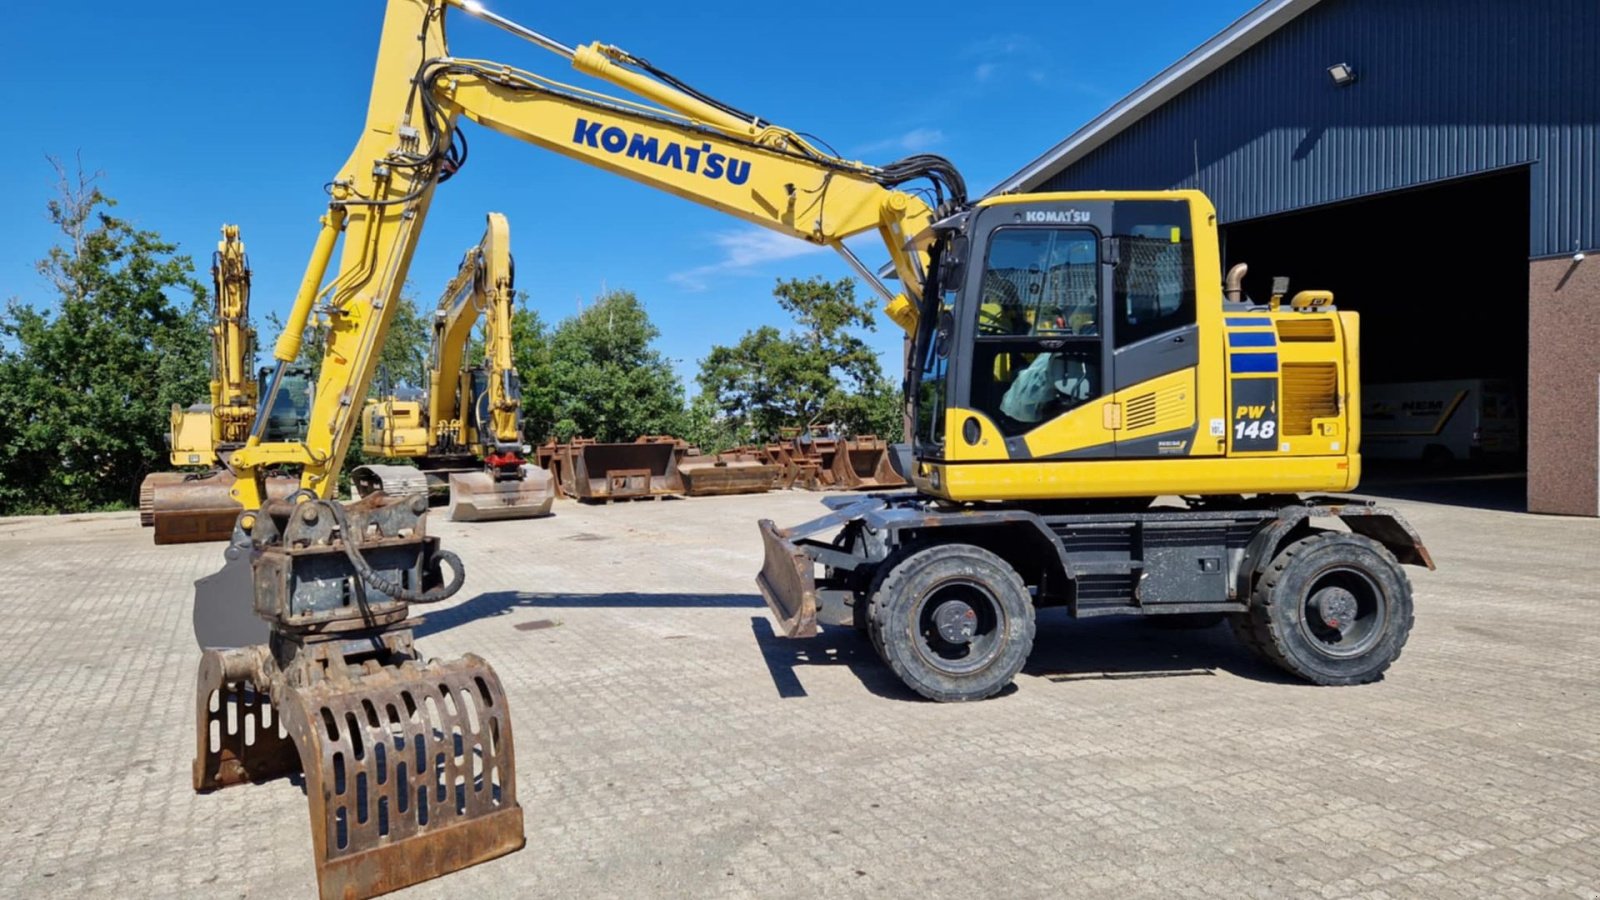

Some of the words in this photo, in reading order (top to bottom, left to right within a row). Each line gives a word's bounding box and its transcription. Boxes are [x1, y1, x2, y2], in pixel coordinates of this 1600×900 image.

[573, 118, 751, 185] KOMATSU
[1026, 209, 1090, 222] KOMATSU
[1236, 406, 1266, 419] PW
[1234, 420, 1276, 439] 148
